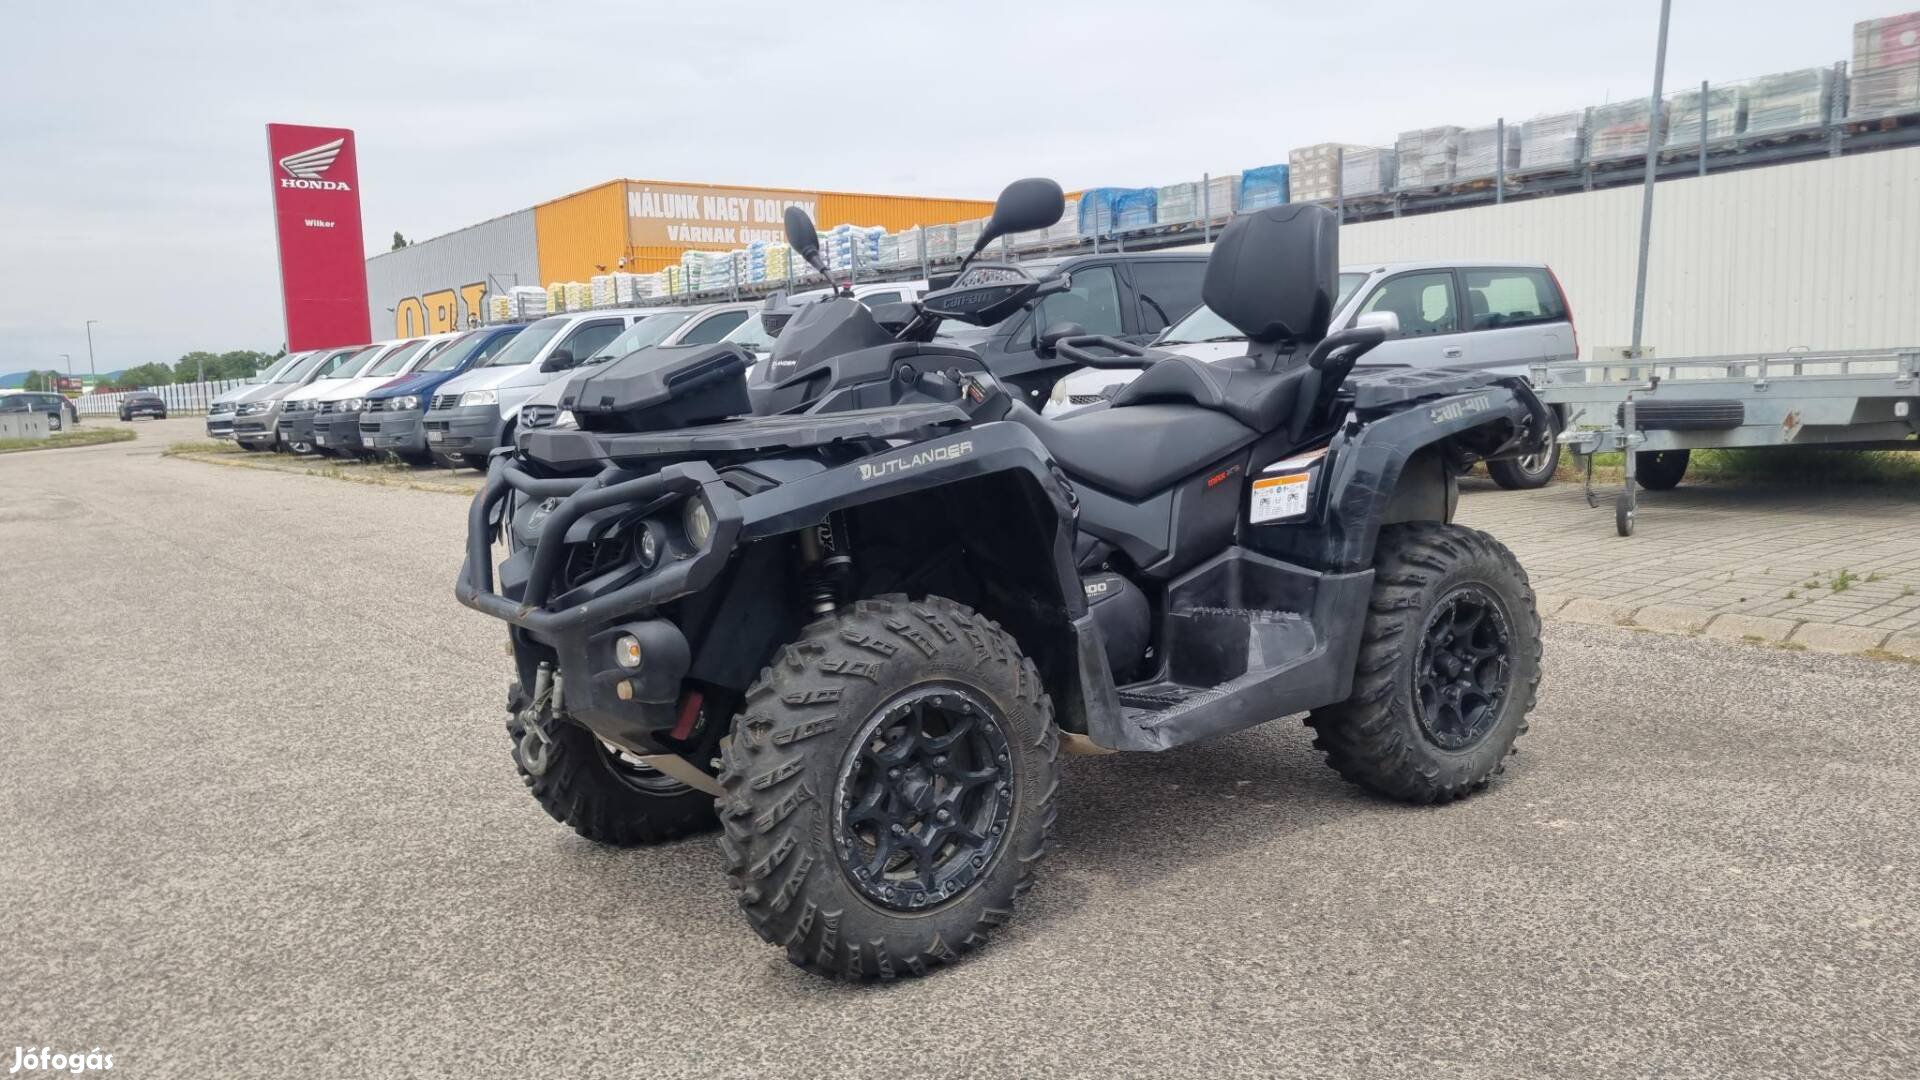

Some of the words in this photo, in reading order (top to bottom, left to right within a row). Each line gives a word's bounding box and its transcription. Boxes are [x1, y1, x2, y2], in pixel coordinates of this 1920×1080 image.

[281, 179, 351, 191] HONDA
[628, 186, 699, 219] NÁLUNK
[704, 195, 750, 222] NAGY
[754, 199, 817, 226] DOLK
[304, 219, 335, 228] Wilker
[667, 223, 737, 244] VÁRNAK
[860, 440, 974, 480] OUTLANDER
